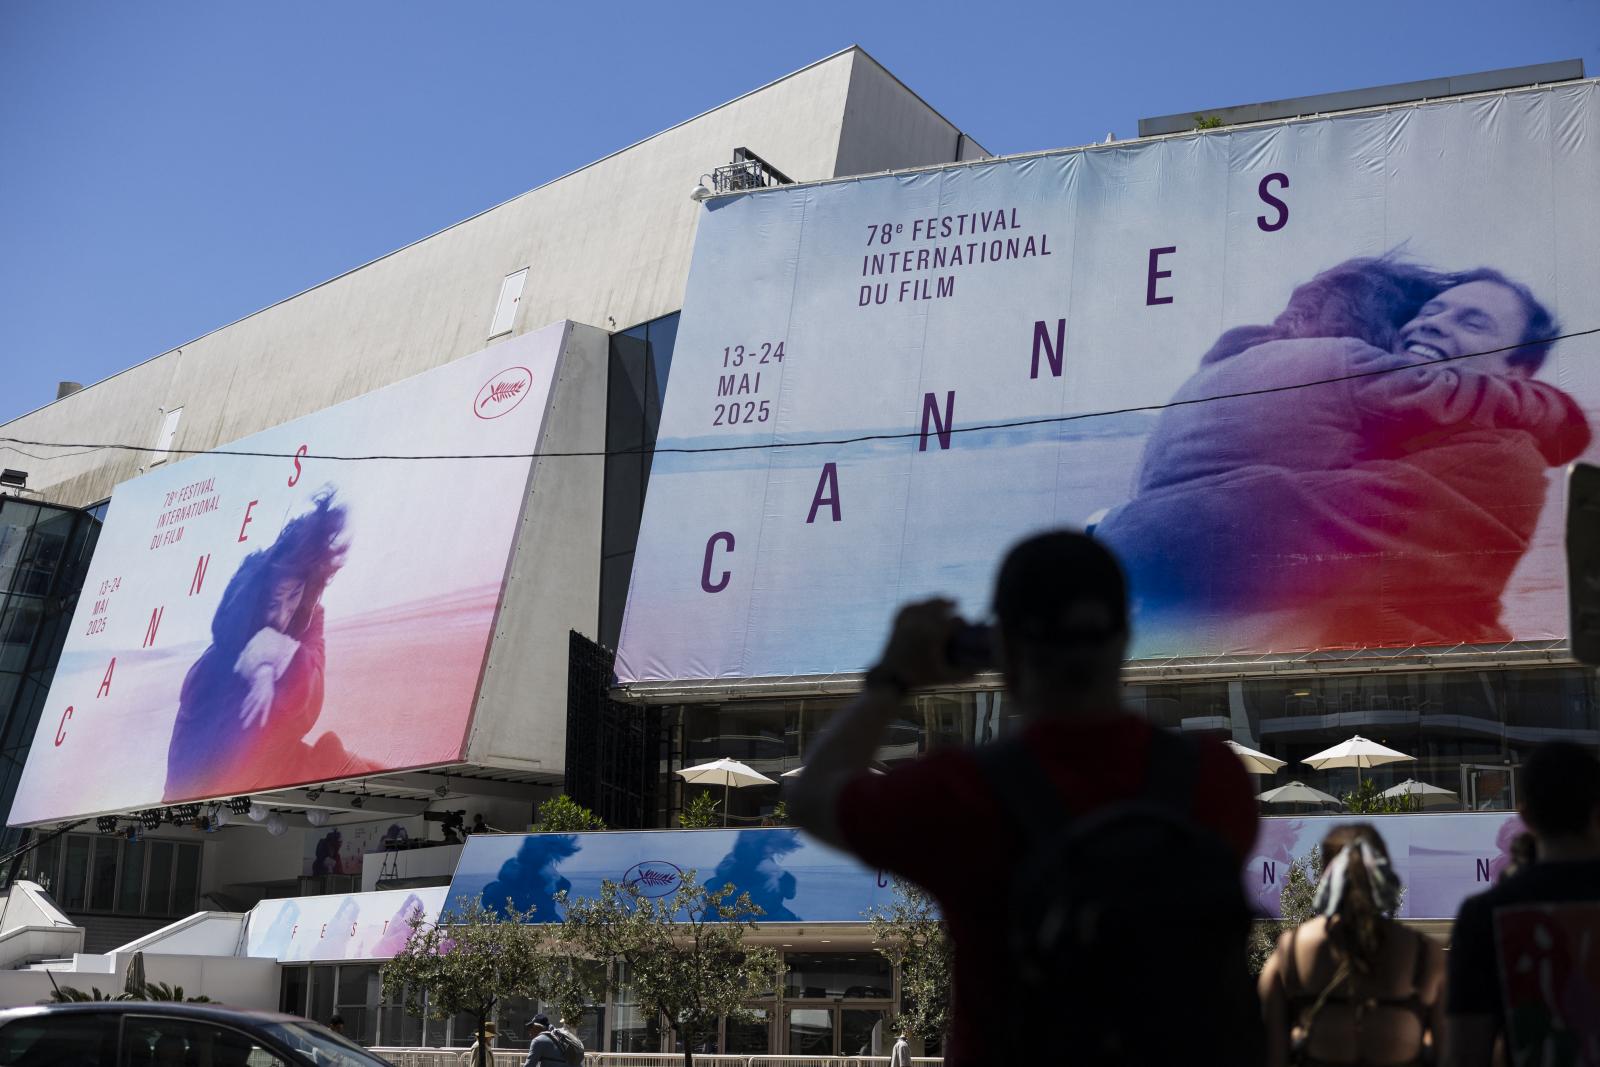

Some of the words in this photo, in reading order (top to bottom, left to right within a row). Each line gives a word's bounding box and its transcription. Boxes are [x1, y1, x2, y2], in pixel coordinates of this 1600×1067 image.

[911, 207, 1022, 242] FESTIVAL
[862, 233, 1053, 277] INTERNATIONAL
[858, 282, 889, 307] DU
[899, 275, 955, 303] FILM
[722, 341, 786, 368] 13-24
[717, 372, 761, 397] MAI
[712, 400, 771, 427] 2025
[178, 477, 216, 503] FESTIVAL
[157, 494, 221, 529] INTERNATIONAL
[150, 533, 164, 551] DU
[163, 526, 185, 546] FILM
[99, 577, 122, 596] 13-24
[92, 597, 110, 615] MAI
[86, 616, 108, 636] 2025
